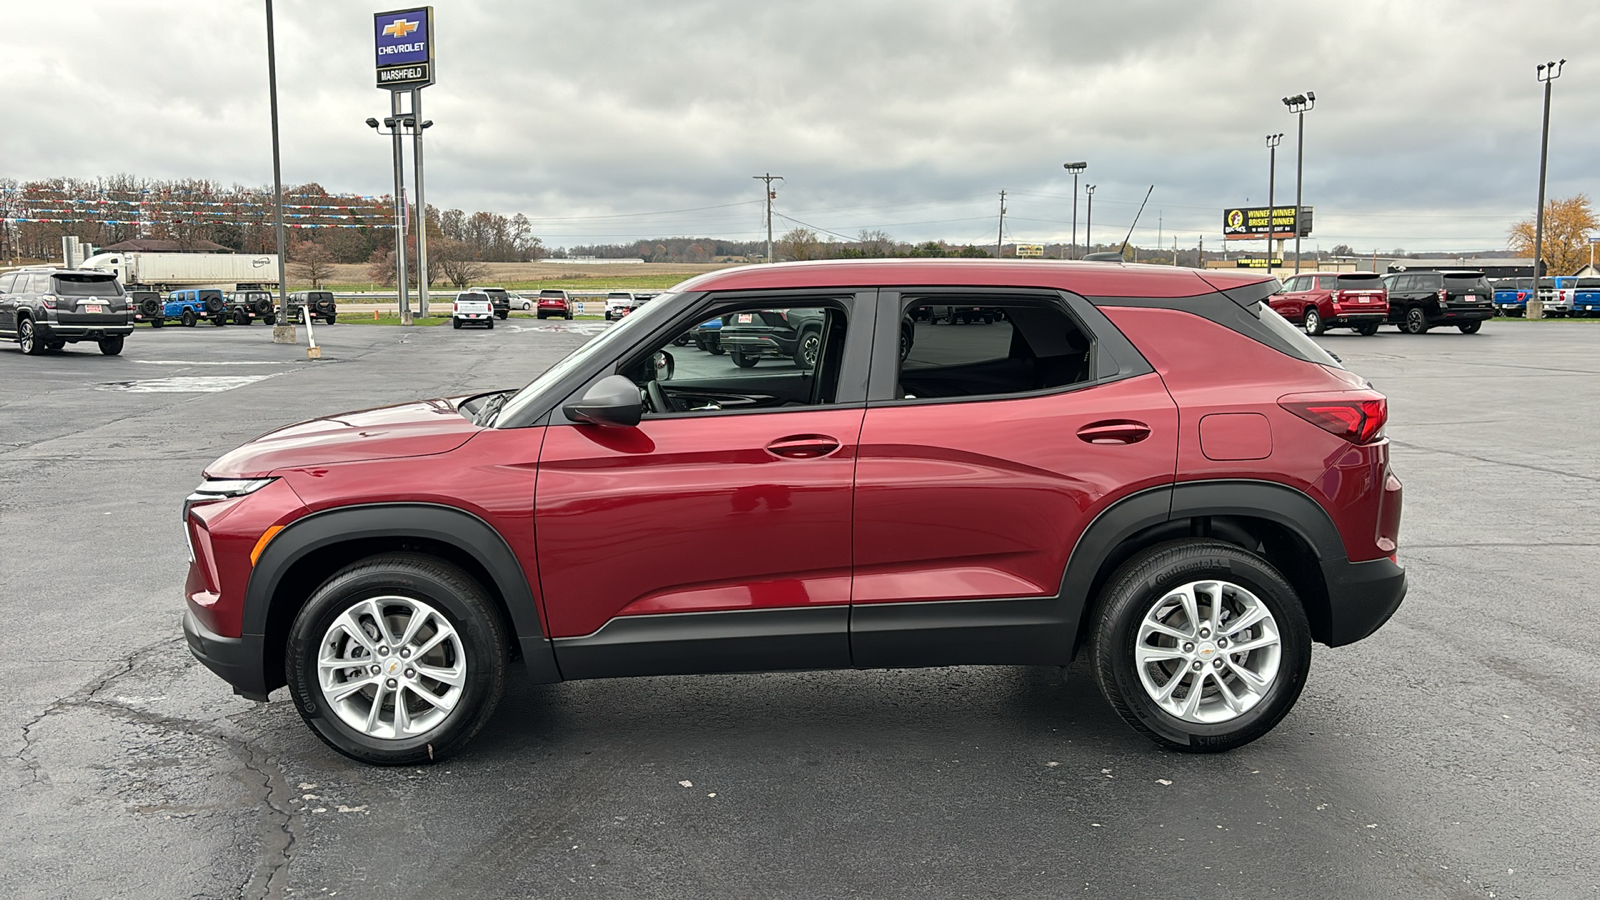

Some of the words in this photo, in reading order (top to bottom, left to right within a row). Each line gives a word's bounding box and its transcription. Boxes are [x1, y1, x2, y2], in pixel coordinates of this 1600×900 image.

[378, 42, 425, 55] CHEVROLET
[381, 67, 422, 81] MARSHFIELD
[1272, 217, 1294, 226] DINNER
[1155, 559, 1213, 585] Continental
[296, 653, 316, 714] Continental
